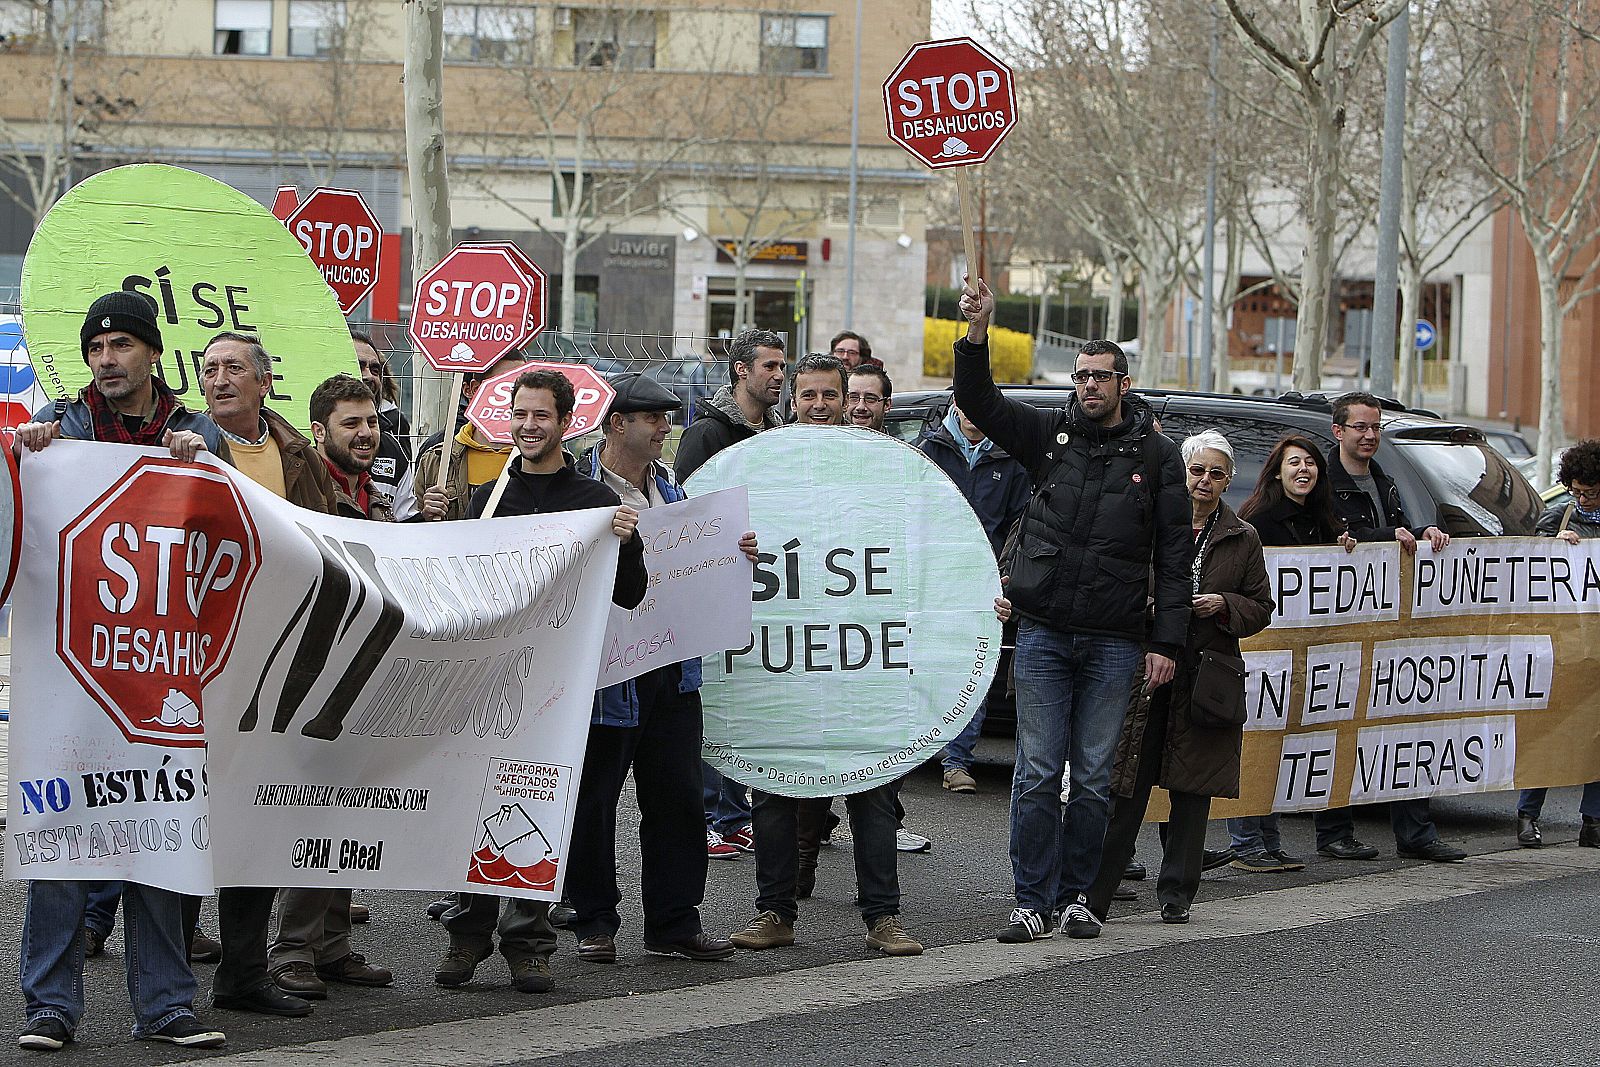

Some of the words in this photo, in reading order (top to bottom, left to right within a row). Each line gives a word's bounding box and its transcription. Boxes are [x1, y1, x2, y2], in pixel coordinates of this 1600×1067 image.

[898, 70, 1000, 117] STOP
[902, 111, 1005, 140] DESAHUCIOS
[296, 220, 373, 260] STOP
[608, 239, 669, 256] Javier
[319, 264, 370, 285] AHUCIOS
[192, 282, 257, 331] SE
[425, 279, 521, 319] STOP
[421, 320, 514, 342] DESAHUCIOS
[642, 517, 722, 554] RCLAYS
[98, 522, 242, 618] STOP
[752, 537, 801, 601] SÍ
[824, 547, 893, 597] SE
[1278, 562, 1393, 616] PEDAL
[1417, 547, 1600, 606] PUÑETERA
[1245, 670, 1287, 719] N
[1308, 663, 1350, 713] EL
[1372, 653, 1544, 708] HOSPITAL
[702, 736, 753, 772] sahucios
[767, 768, 815, 786] Dación
[819, 774, 836, 785] en
[840, 766, 874, 786] pago
[877, 726, 942, 772] retroactiva
[942, 678, 978, 725] Alquiler
[19, 777, 72, 815] NO
[81, 754, 196, 807] ESTÁS
[498, 762, 560, 778] PLATAFORMA
[500, 774, 558, 788] AFECTADOS
[1283, 750, 1331, 801] TE
[253, 784, 430, 811] PAHCIUDADREAL.WORDPRESS.COM
[505, 787, 555, 802] HIPOTECA
[13, 818, 182, 865] ESTAMOS
[291, 838, 384, 874] @PAH_CReal
